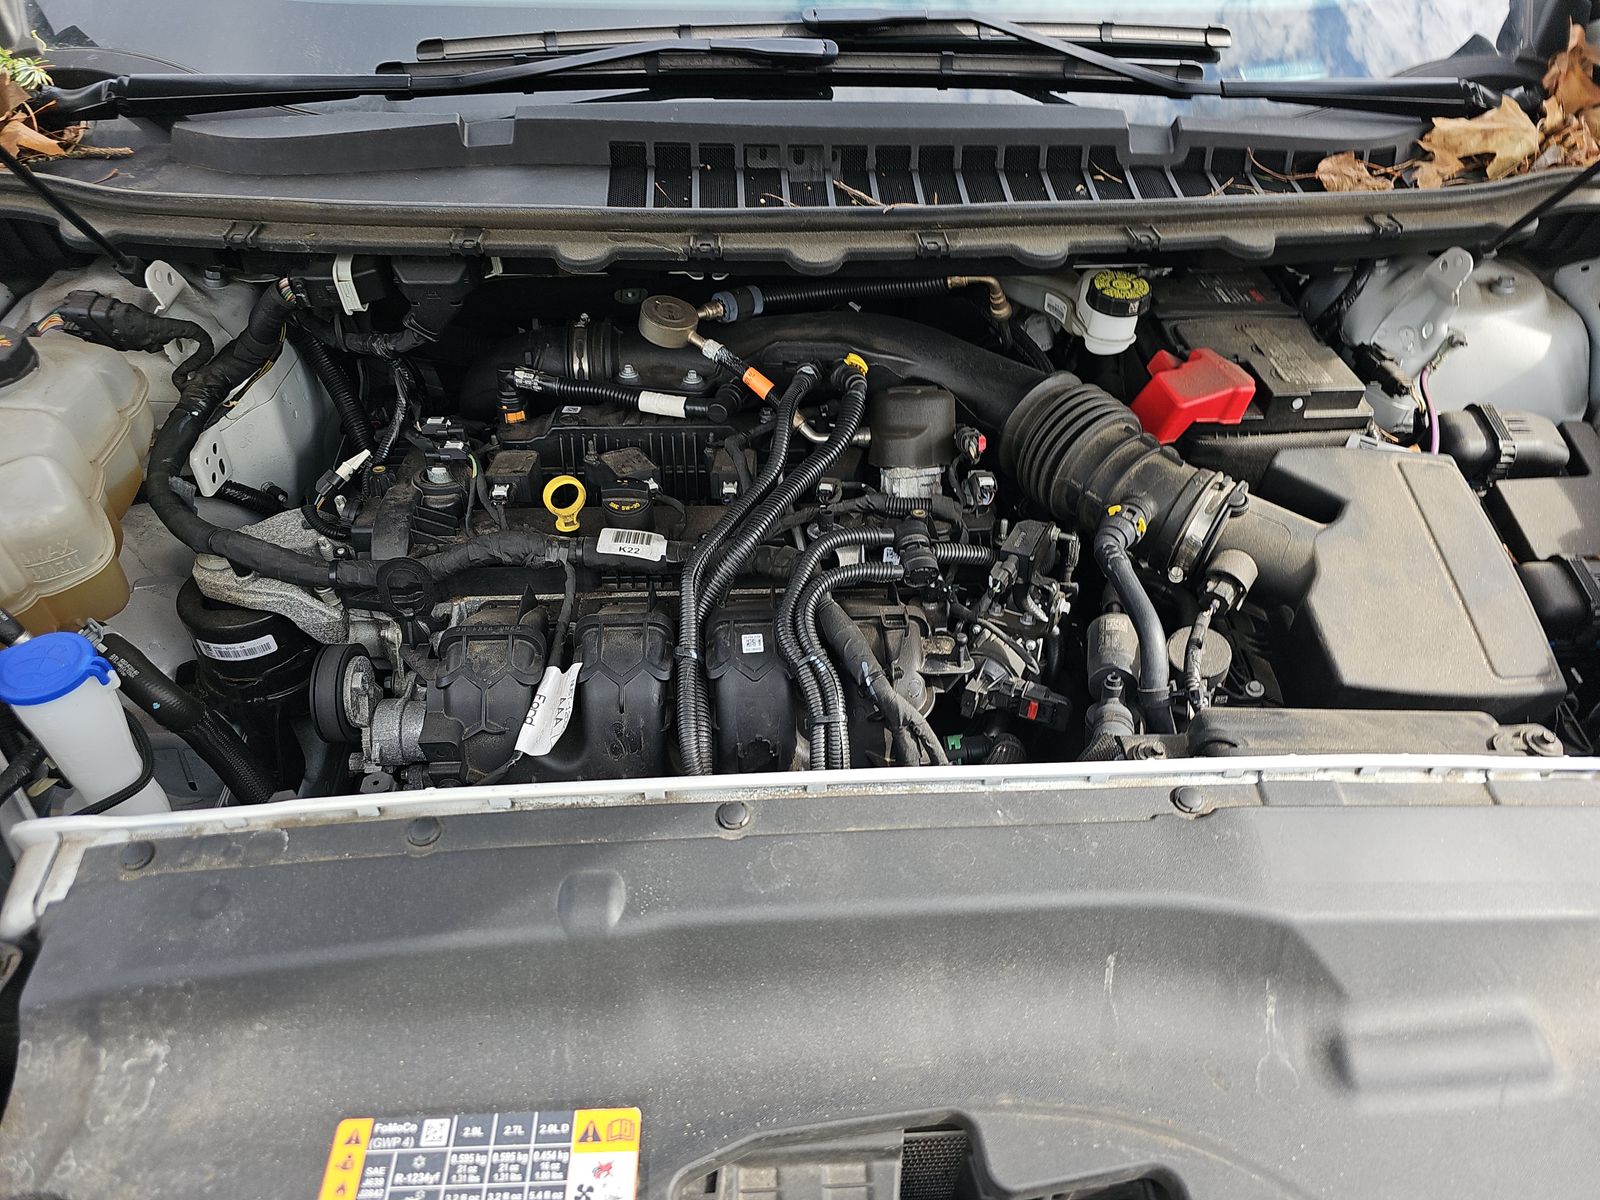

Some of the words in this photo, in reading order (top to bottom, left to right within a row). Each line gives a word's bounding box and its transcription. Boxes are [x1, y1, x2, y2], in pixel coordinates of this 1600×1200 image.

[618, 546, 640, 555] K22
[524, 693, 546, 726] Ford
[374, 1122, 418, 1134] FoMoCo
[503, 1124, 525, 1136] 2.7L
[369, 1136, 402, 1149] (GWP
[402, 1136, 415, 1148] 4)
[475, 1153, 488, 1167] kg
[516, 1152, 529, 1165] kg
[557, 1150, 570, 1164] kg
[365, 1166, 386, 1177] SAE
[393, 1171, 441, 1185] R-1234yf
